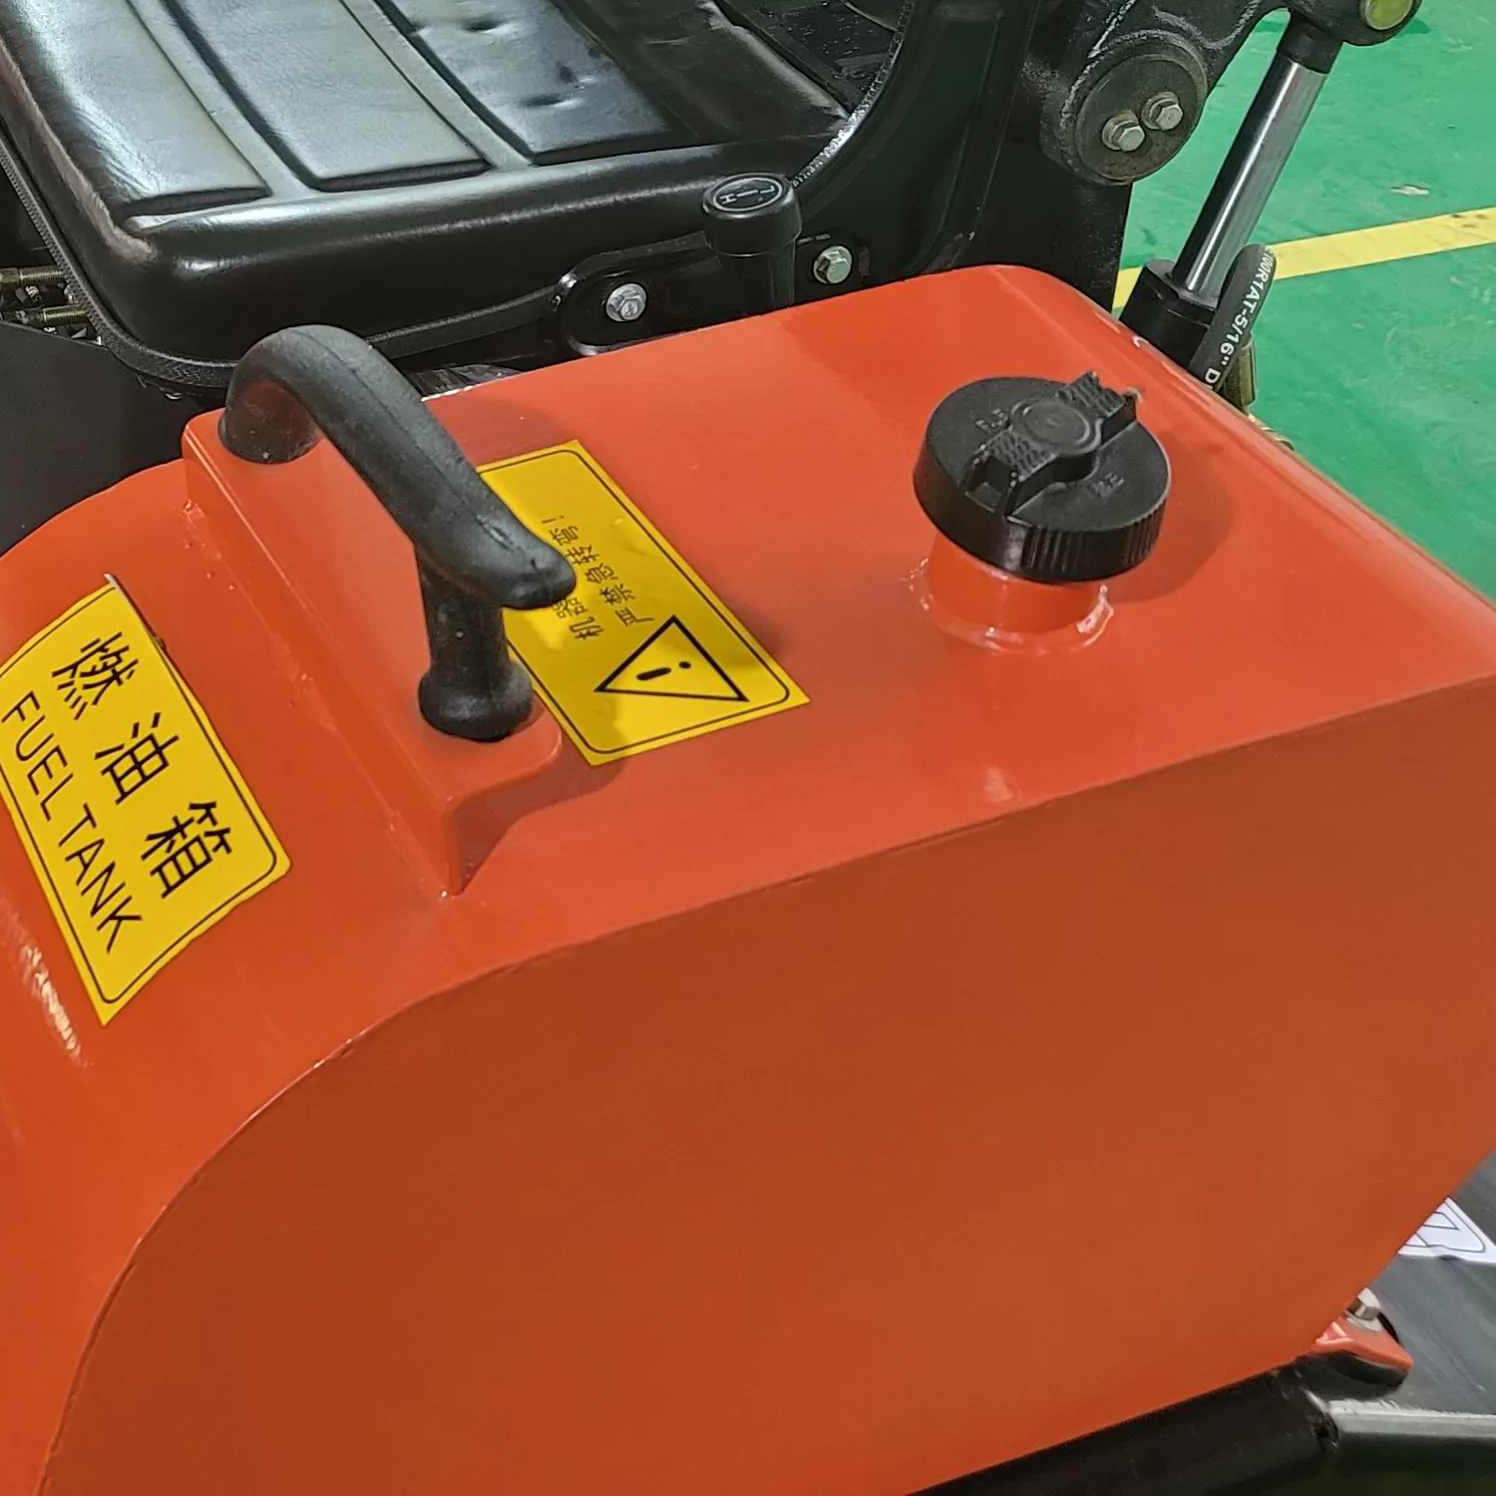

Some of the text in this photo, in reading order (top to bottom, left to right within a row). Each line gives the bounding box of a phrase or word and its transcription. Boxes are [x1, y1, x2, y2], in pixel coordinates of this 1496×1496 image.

[719, 193, 737, 205] H
[1, 690, 143, 955] FUEL TANK
[51, 631, 233, 900] 燃油箱
